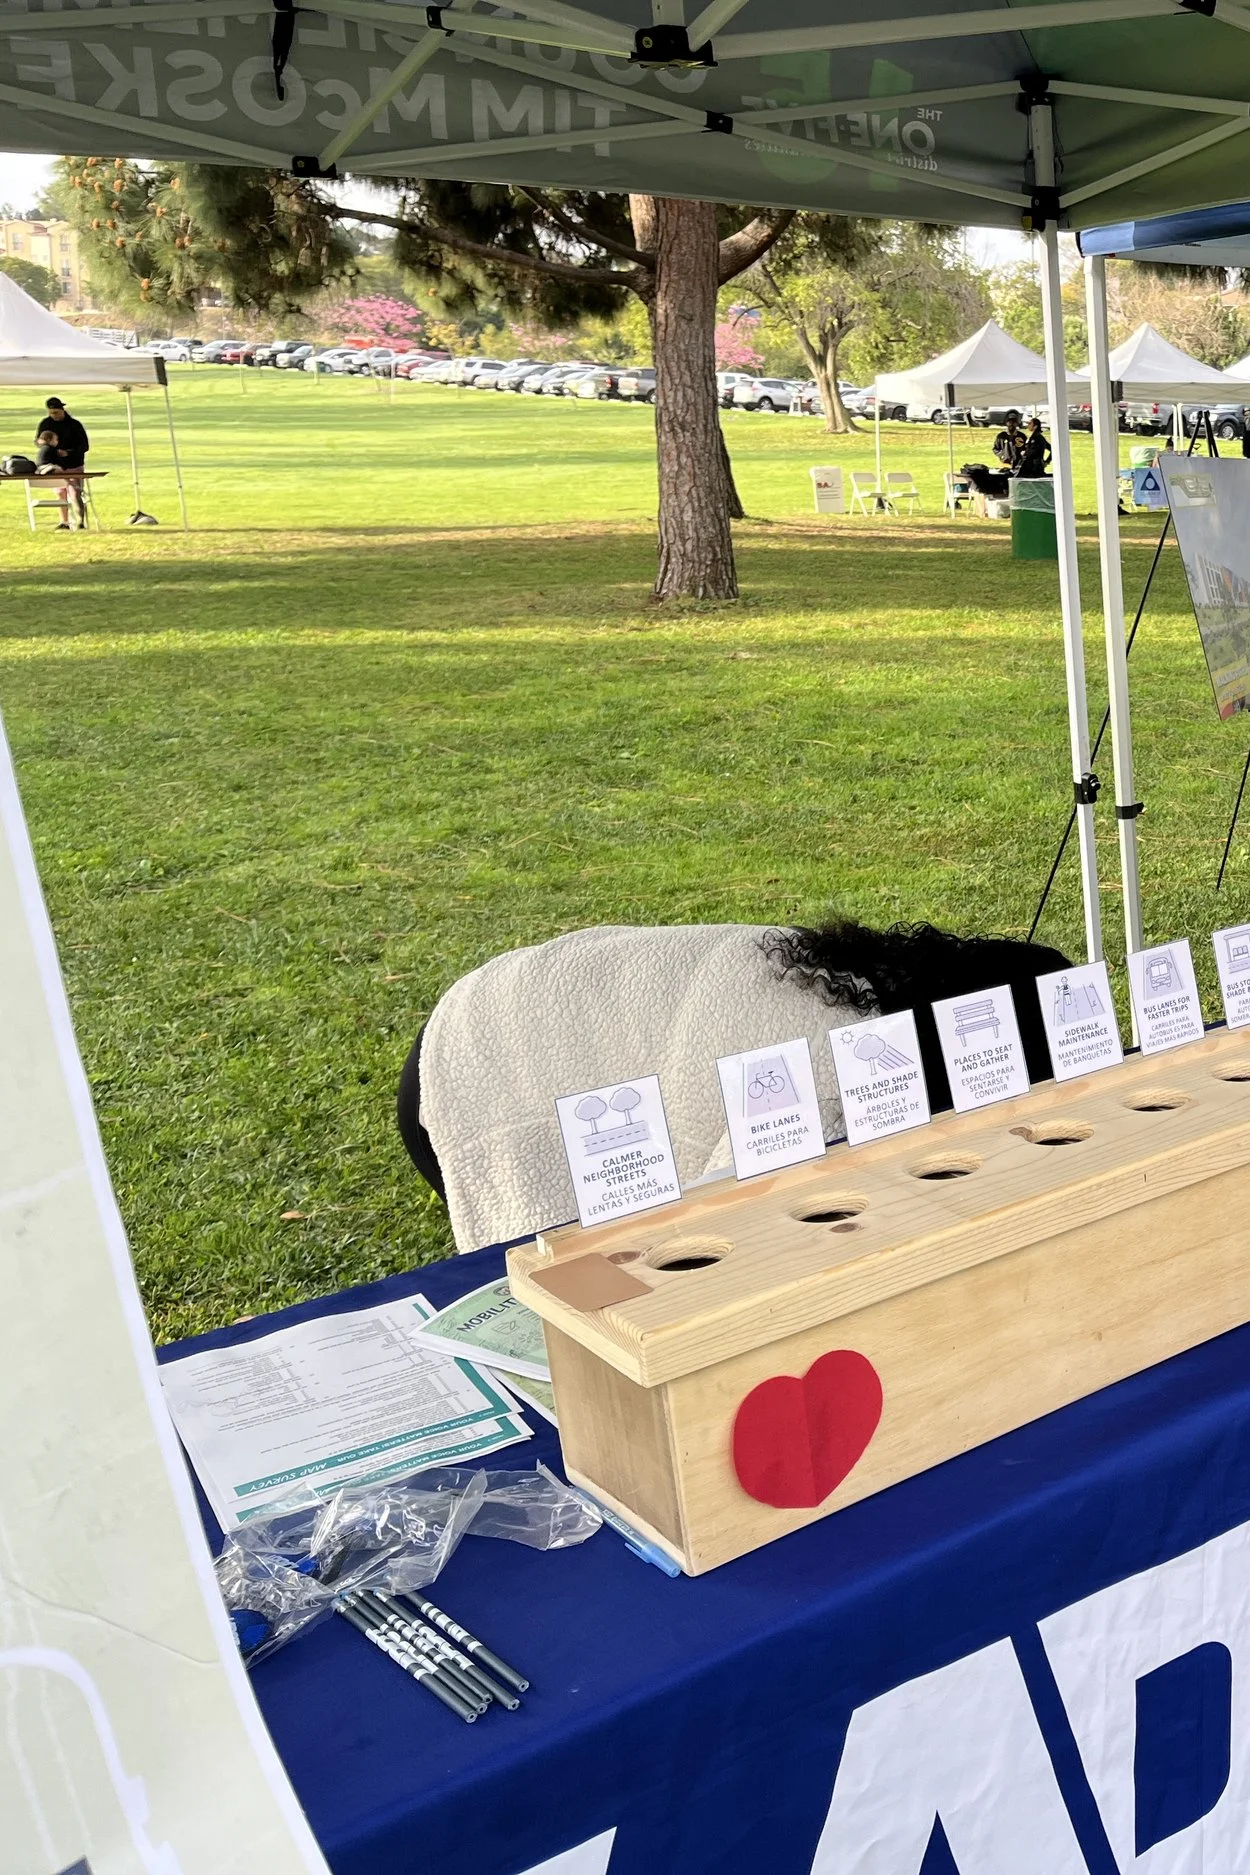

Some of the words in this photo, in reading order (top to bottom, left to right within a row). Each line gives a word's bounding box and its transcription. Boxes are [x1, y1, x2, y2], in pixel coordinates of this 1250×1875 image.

[1226, 988, 1246, 999] SHADE
[1227, 983, 1239, 991] BUS
[1144, 1005, 1157, 1014] BUS
[1157, 1000, 1177, 1011] LANES
[1177, 995, 1191, 1004] FOR
[1148, 1009, 1171, 1021] FASTER
[1171, 1003, 1189, 1014] TRIPS
[1058, 1027, 1109, 1048] MAINTENANCE
[1064, 1022, 1099, 1038] SIDEWALK
[953, 1052, 981, 1067] PLACES
[983, 1049, 993, 1058] TO
[994, 1043, 1013, 1055] SEAT
[1058, 1039, 1114, 1061] MANTENIMIENTO
[1063, 1059, 1072, 1068] DE
[1073, 1047, 1112, 1064] BANQUETAS
[961, 1061, 978, 1073] AND
[979, 1053, 1010, 1068] GATHER
[844, 1084, 871, 1098] TREES
[872, 1079, 890, 1091] AND
[891, 1070, 919, 1085] SHADE
[961, 1070, 996, 1087] ESPACIOS
[996, 1065, 1015, 1076] PARA
[969, 1076, 1004, 1093] SENTARSE
[857, 1082, 909, 1104] STRUCTURES
[901, 1096, 906, 1105] Y
[974, 1083, 1009, 1099] CONVIVIR
[750, 1121, 771, 1135] BIKE
[772, 1113, 801, 1129] LANES
[854, 1105, 909, 1128] ESTRUCTURAS
[909, 1101, 920, 1111] DE
[872, 1115, 906, 1131] SOMBRA
[746, 1132, 786, 1151] CARRILES
[786, 1125, 810, 1138] PARA
[756, 1136, 803, 1157] BICICLETAS
[583, 1153, 665, 1184] NEIGHBORHOOD
[602, 1150, 643, 1169] CALMER
[605, 1168, 647, 1188] STREETS
[588, 1198, 624, 1217] LENTAS
[624, 1195, 631, 1205] Y
[632, 1183, 675, 1203] SEGURAS
[601, 1185, 636, 1203] CALLES
[424, 1422, 450, 1433] VOICE
[449, 1417, 473, 1428] YOUR
[357, 1444, 381, 1457] TAKE
[430, 1449, 458, 1460] VOICE
[458, 1442, 483, 1452] YOUR
[336, 1452, 358, 1463] OUR
[300, 1461, 328, 1479] MAP
[250, 1470, 297, 1491] SURVEY
